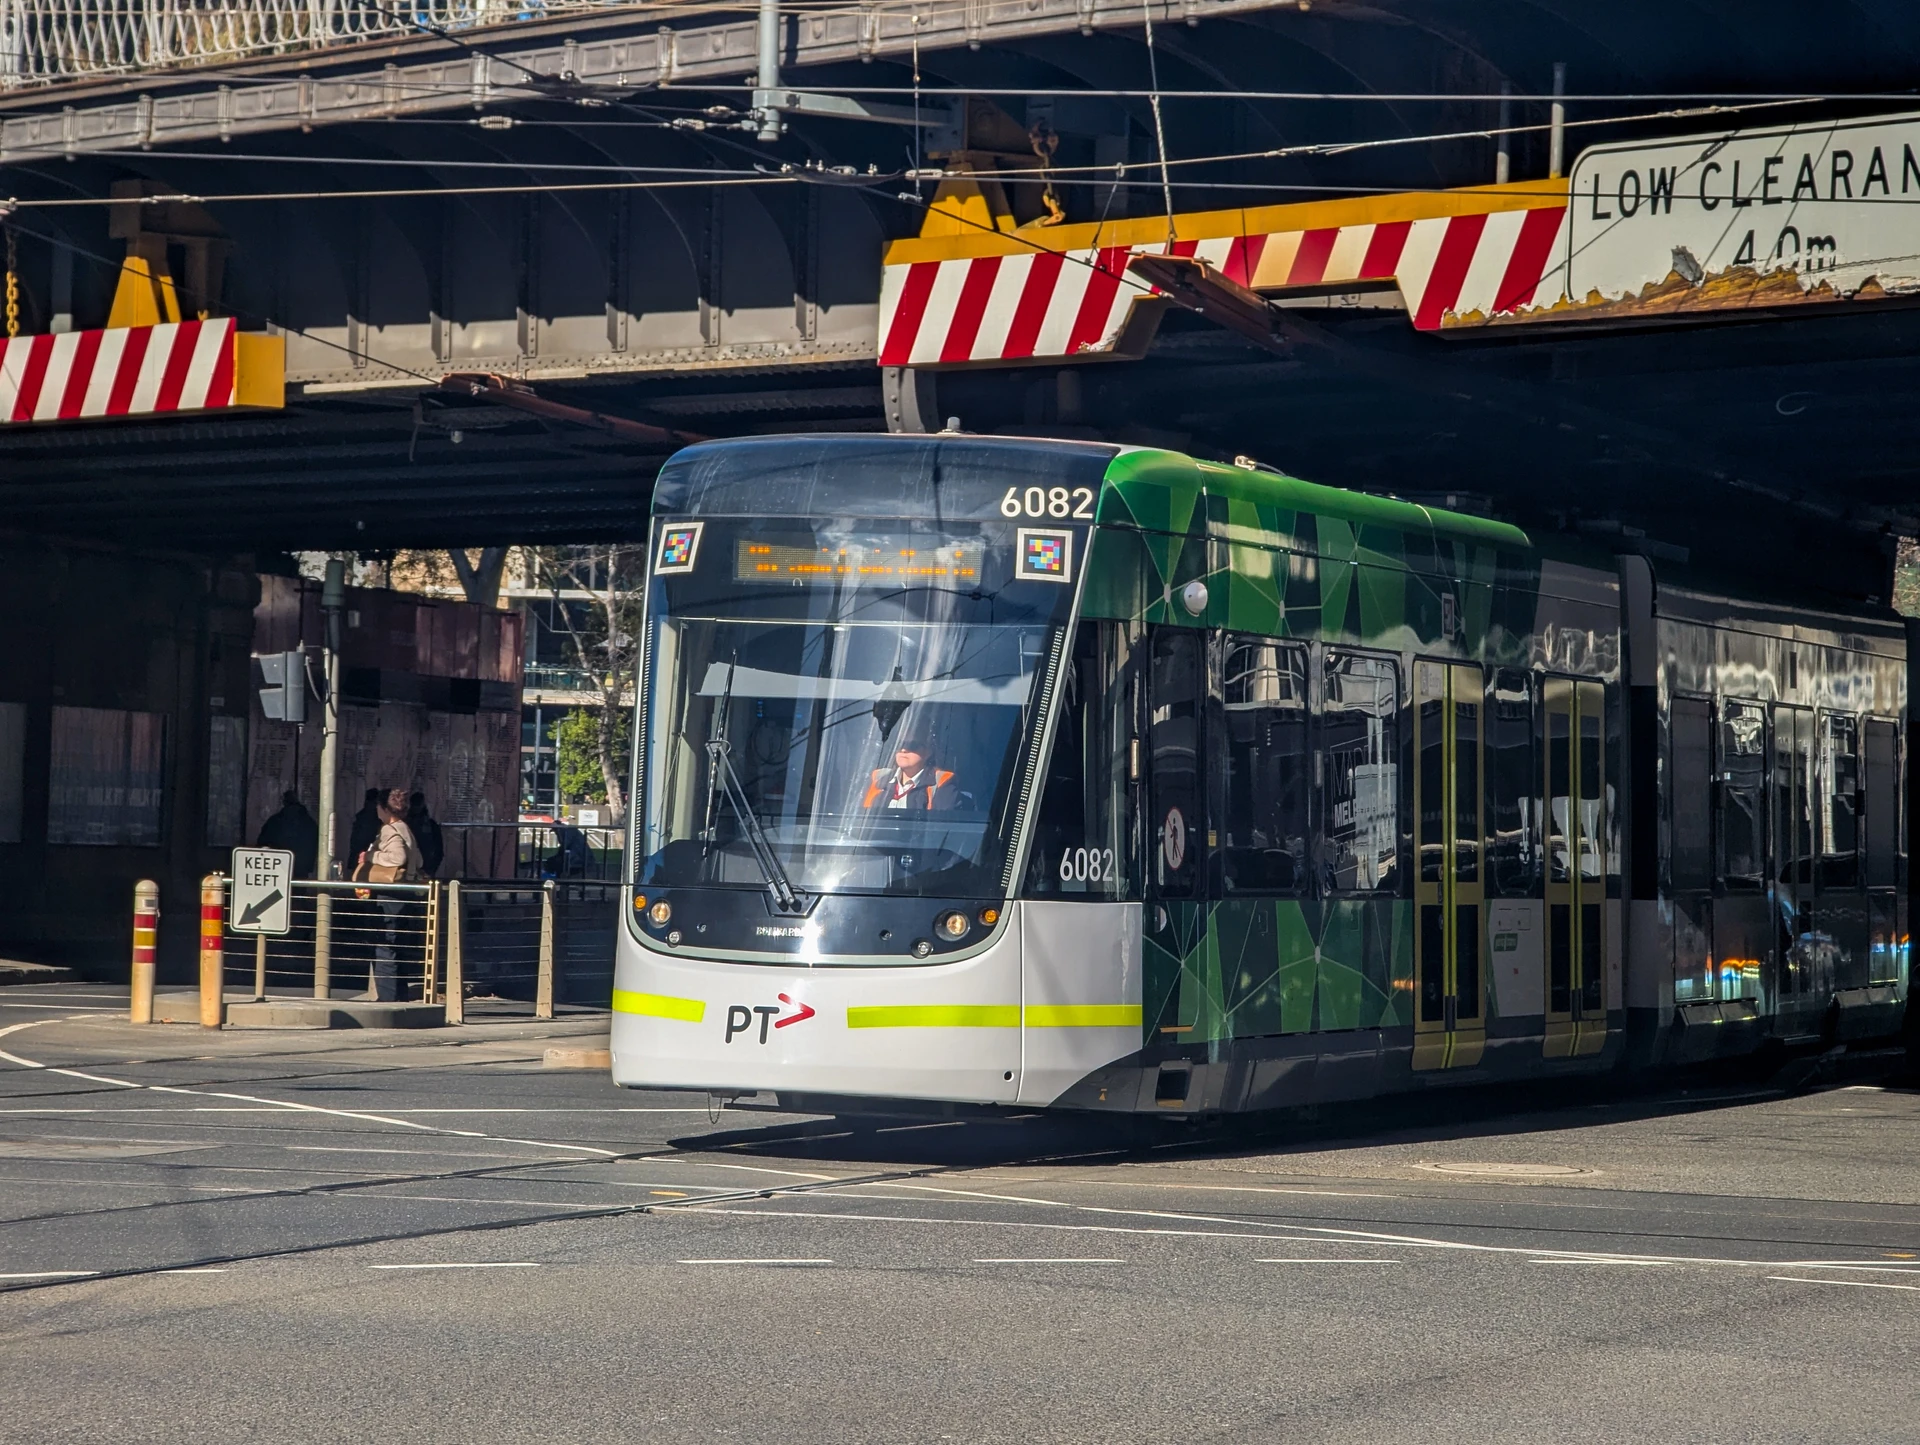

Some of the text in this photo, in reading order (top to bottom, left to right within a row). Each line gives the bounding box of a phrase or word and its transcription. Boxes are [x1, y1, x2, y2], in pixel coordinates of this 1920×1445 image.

[1592, 165, 1678, 221] LOW
[1000, 486, 1094, 519] 6082
[244, 856, 282, 871] KEEP
[245, 873, 279, 887] LEFT
[1059, 847, 1114, 882] 6082
